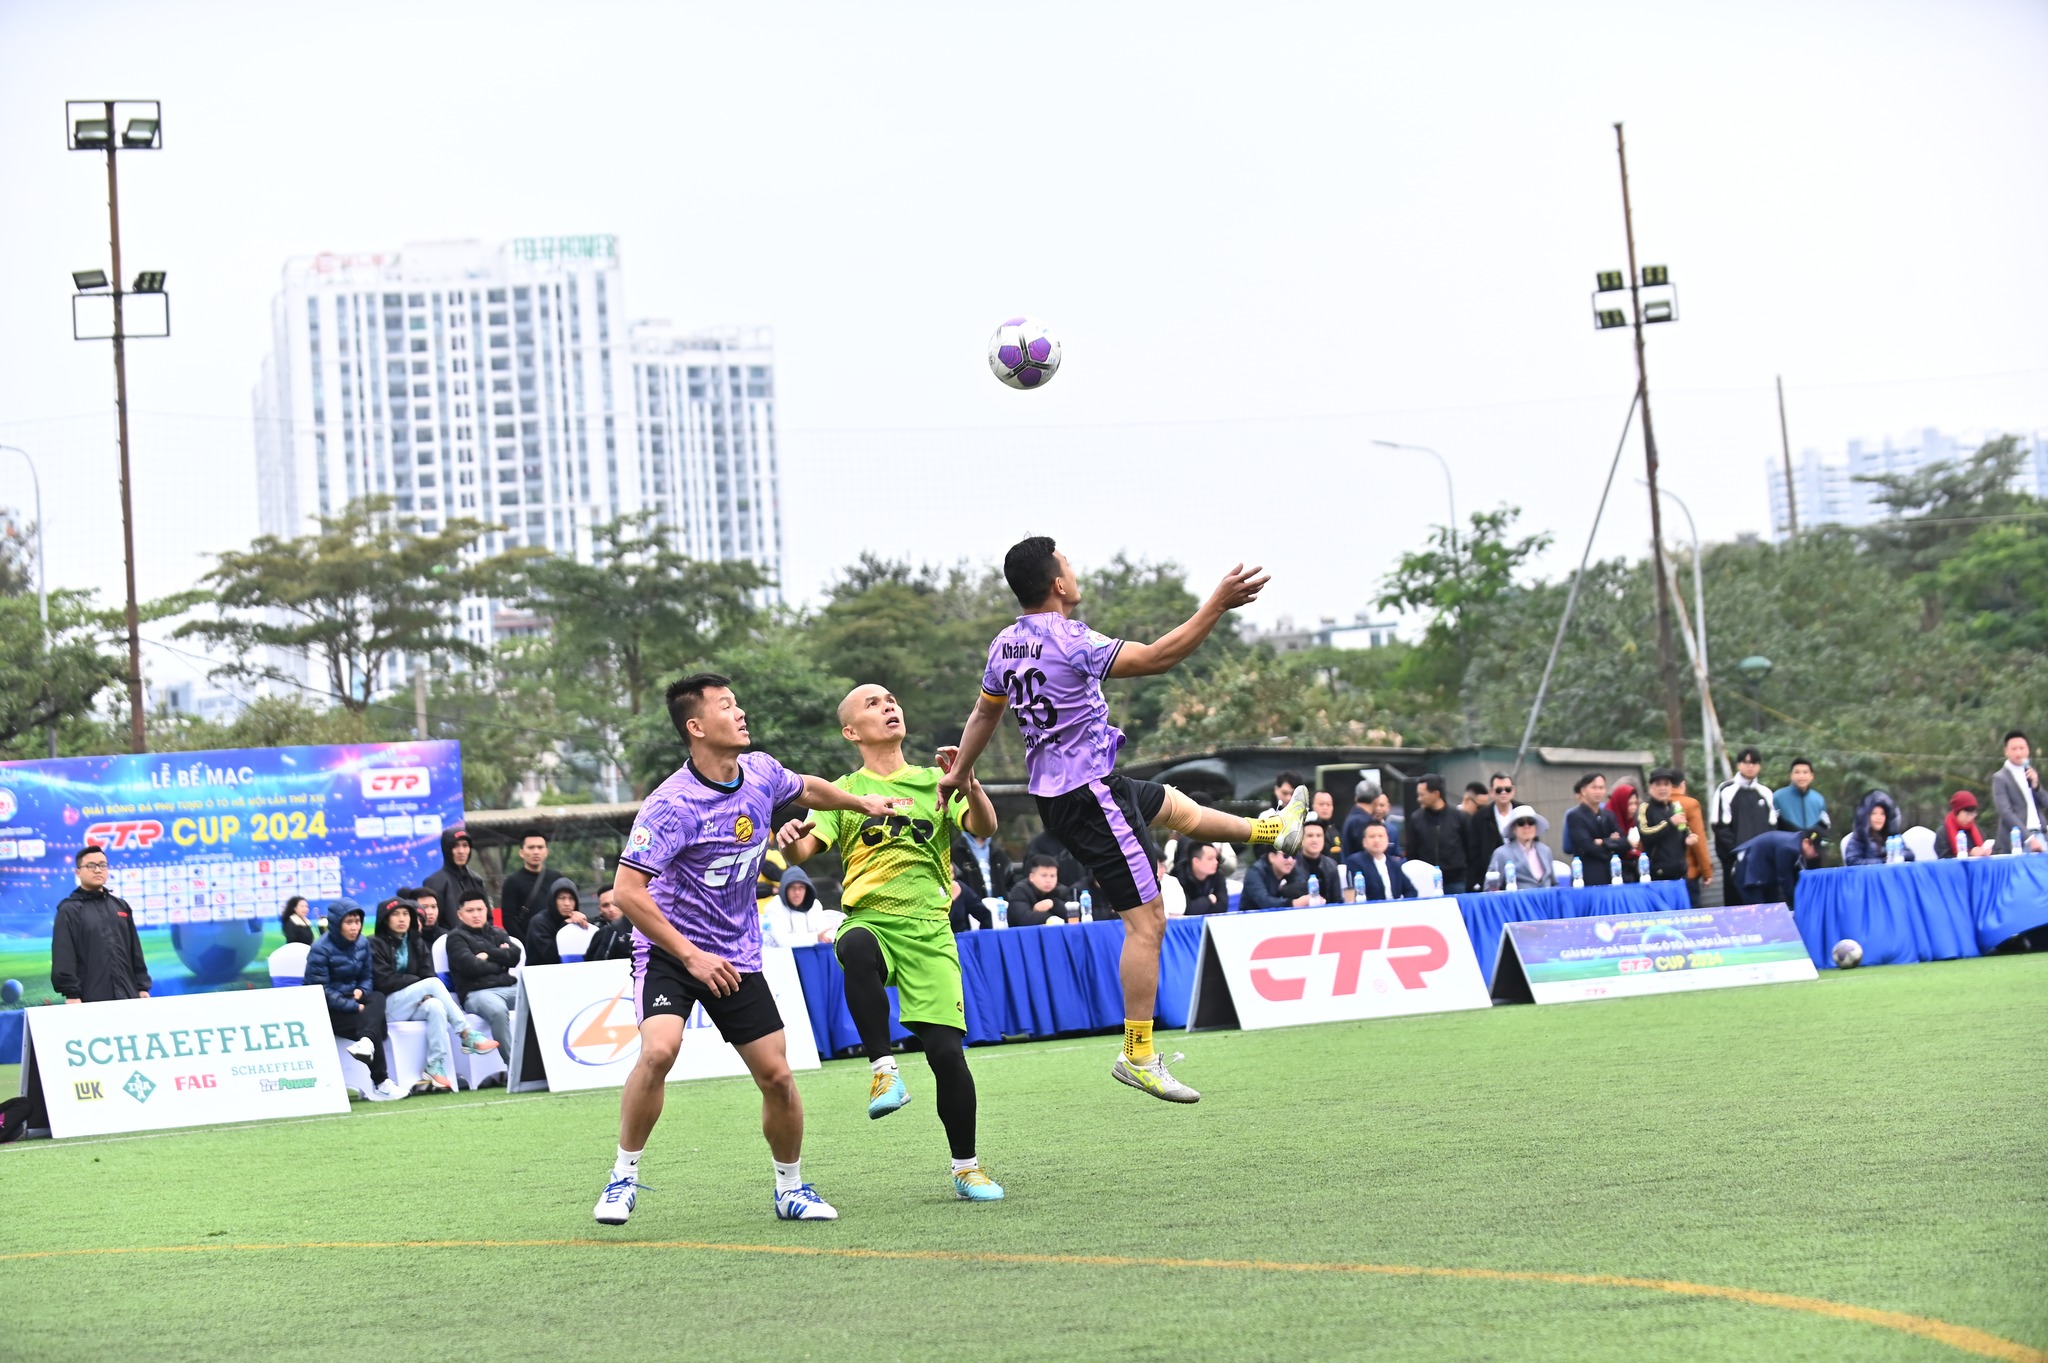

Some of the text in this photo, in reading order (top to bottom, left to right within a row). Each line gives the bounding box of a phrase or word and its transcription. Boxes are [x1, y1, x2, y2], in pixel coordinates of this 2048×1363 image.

[1002, 642, 1029, 659] Khánh
[1003, 667, 1058, 730] 26
[151, 761, 254, 790] LỄ BẾ MẠC
[371, 774, 420, 791] CTR
[85, 820, 164, 850] CTR
[172, 815, 241, 847] CUP
[250, 810, 329, 842] 2024
[860, 815, 934, 847] CTR
[1249, 924, 1450, 1002] CTR
[1619, 957, 1653, 974] CTR
[1655, 954, 1686, 972] CUP
[1687, 952, 1725, 969] 2024
[65, 1020, 310, 1067] SCHAEFFLER
[174, 1073, 218, 1091] FAG
[231, 1059, 315, 1077] SCHAEFFLER
